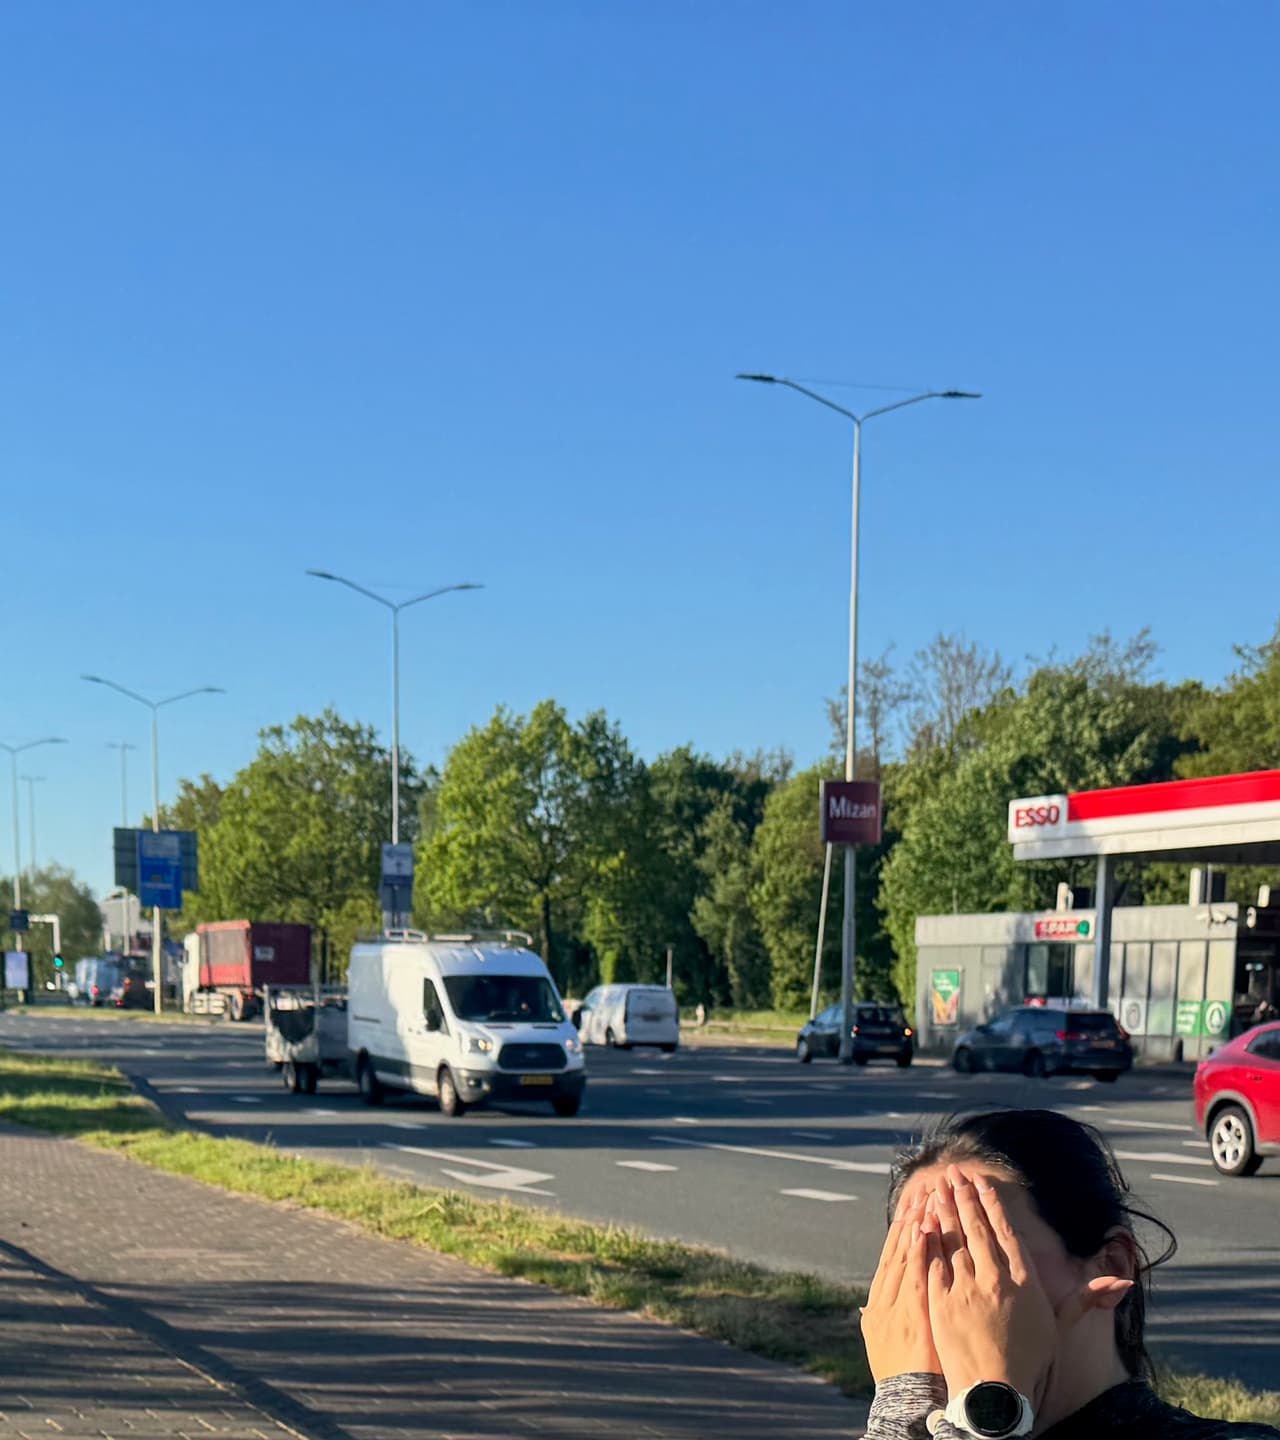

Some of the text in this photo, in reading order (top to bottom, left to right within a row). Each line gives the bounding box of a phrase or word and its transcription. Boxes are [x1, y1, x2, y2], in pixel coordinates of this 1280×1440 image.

[829, 796, 877, 819] Mizan
[1015, 805, 1060, 828] ESSO
[1040, 920, 1078, 937] SPAR
